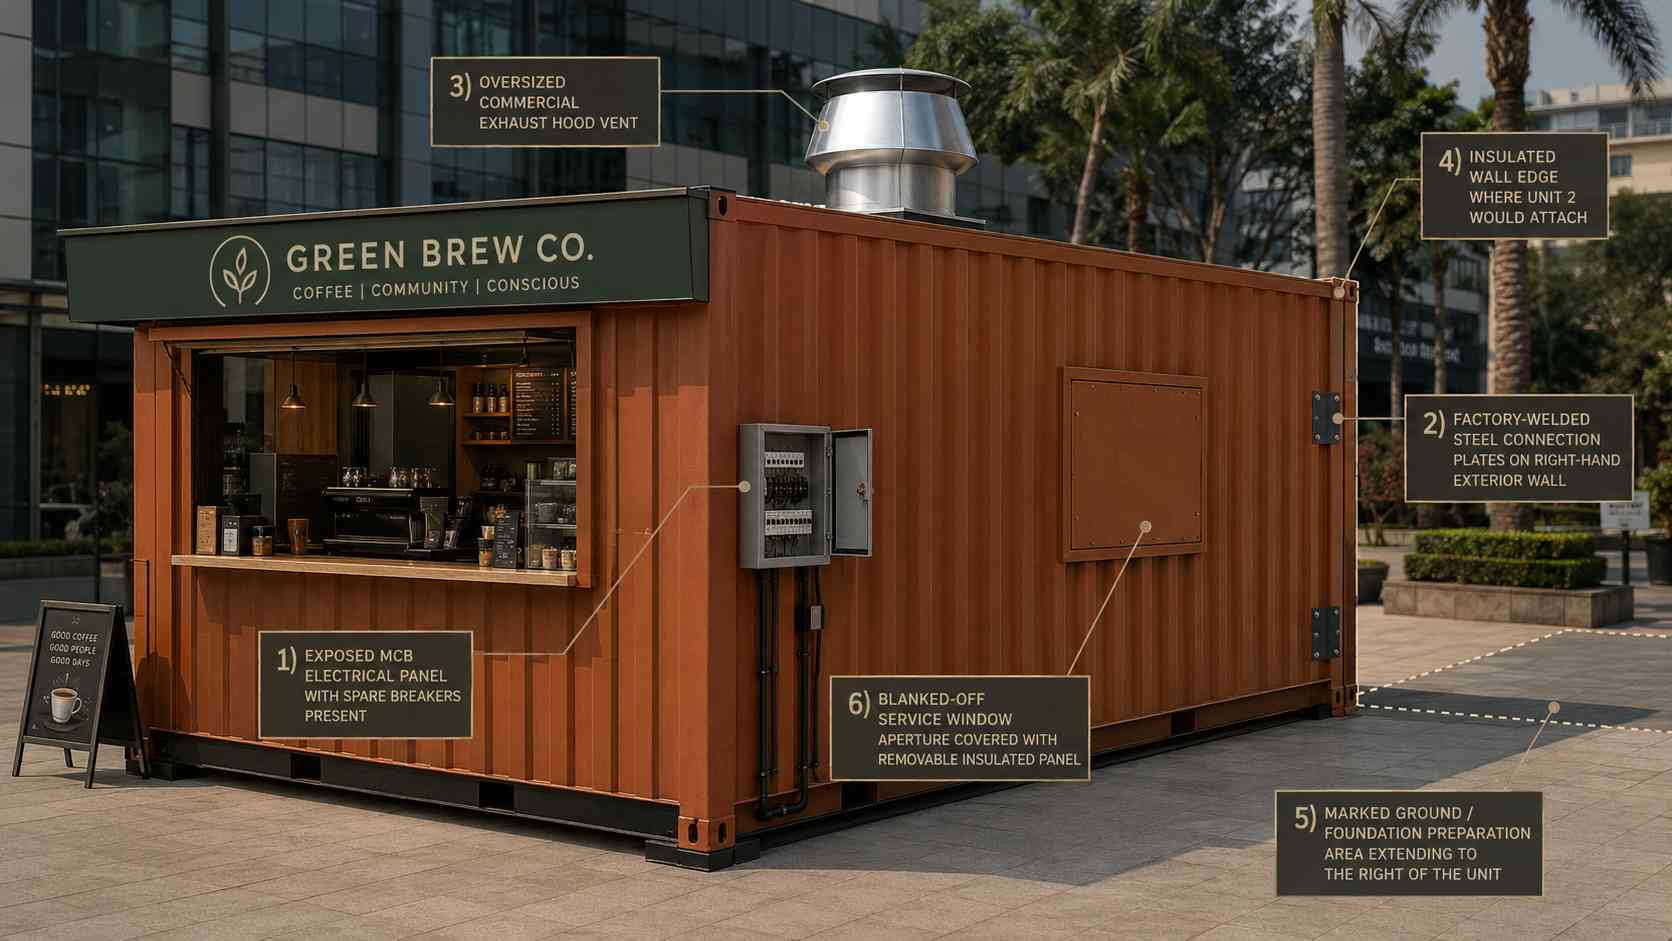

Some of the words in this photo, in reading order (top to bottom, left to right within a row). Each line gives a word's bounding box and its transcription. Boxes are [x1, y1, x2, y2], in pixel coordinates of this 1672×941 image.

[286, 240, 404, 273] GREEN
[422, 235, 524, 267] BREW
[536, 232, 594, 263] CO.
[293, 284, 353, 300] COFFEE
[371, 280, 468, 297] COMMUNITY
[487, 276, 580, 293] CONSCIOUS
[51, 631, 71, 640] GOOD
[72, 632, 98, 642] COFFEE
[50, 644, 69, 652] GOOD
[71, 645, 96, 654] PEOPLE
[50, 656, 70, 665] GOOD
[72, 658, 91, 668] DAYS
